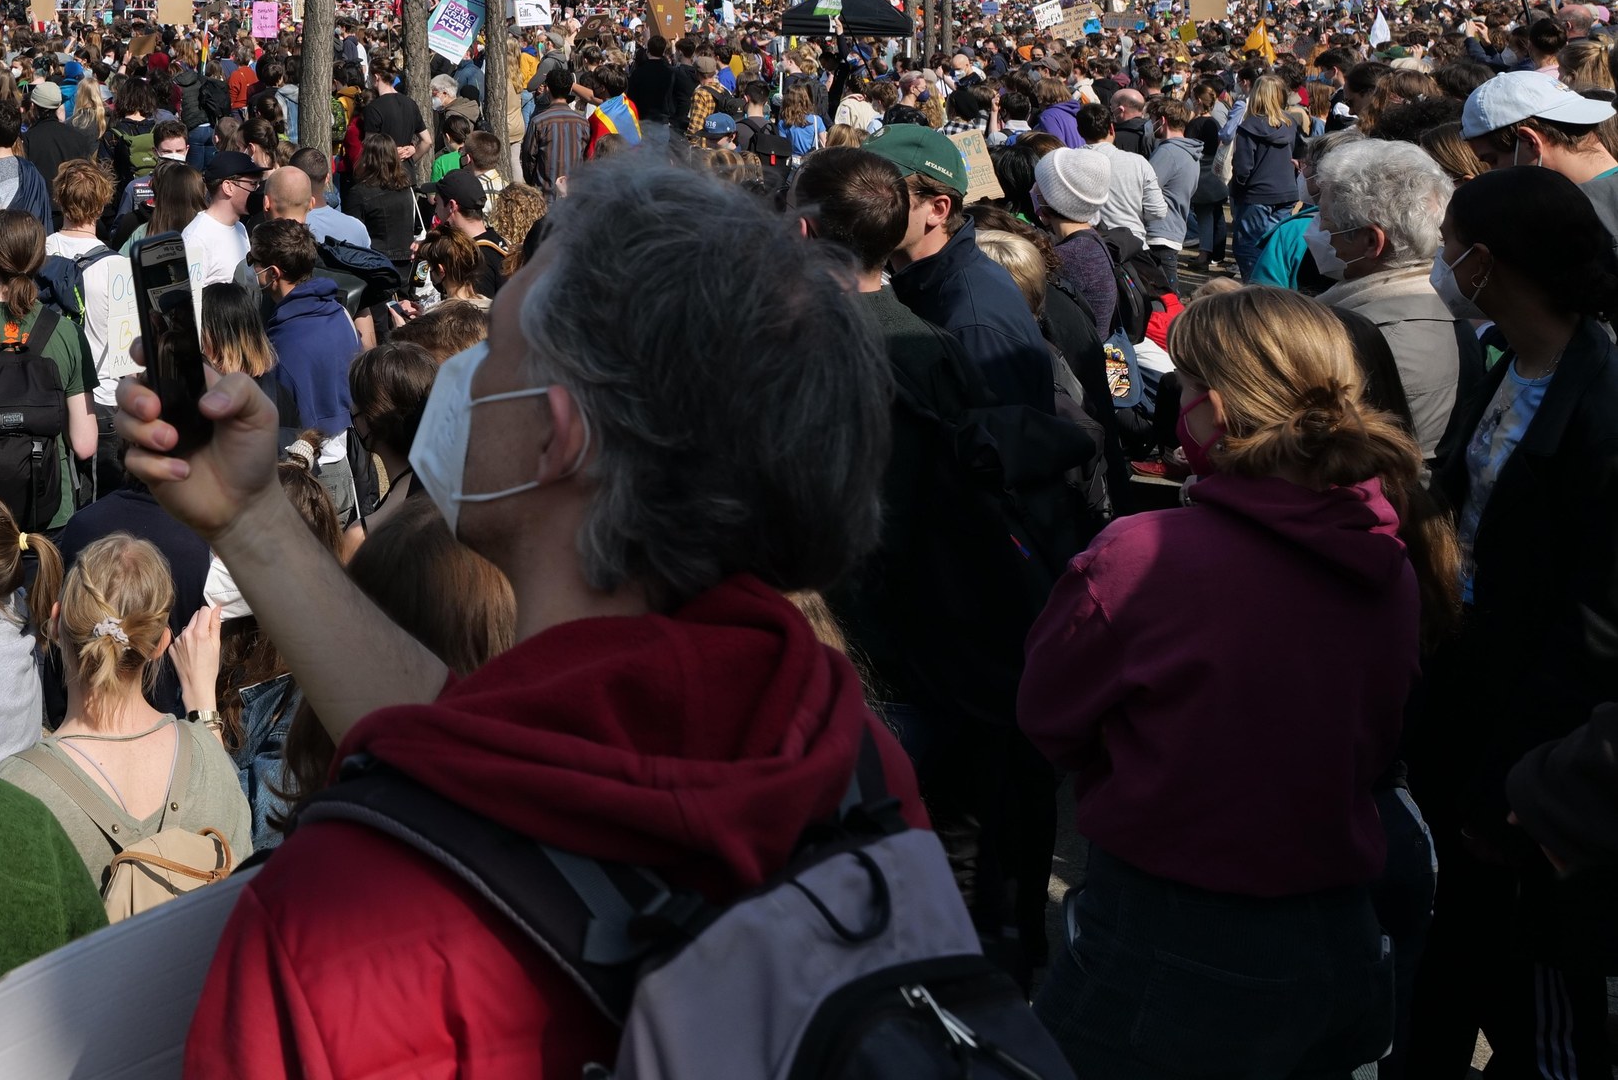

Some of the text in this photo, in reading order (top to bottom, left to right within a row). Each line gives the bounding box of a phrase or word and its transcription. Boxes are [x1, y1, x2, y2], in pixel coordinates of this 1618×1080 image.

[444, 8, 472, 28] KRATIE
[448, 2, 475, 22] DEMO
[924, 160, 954, 178] MYANMAR
